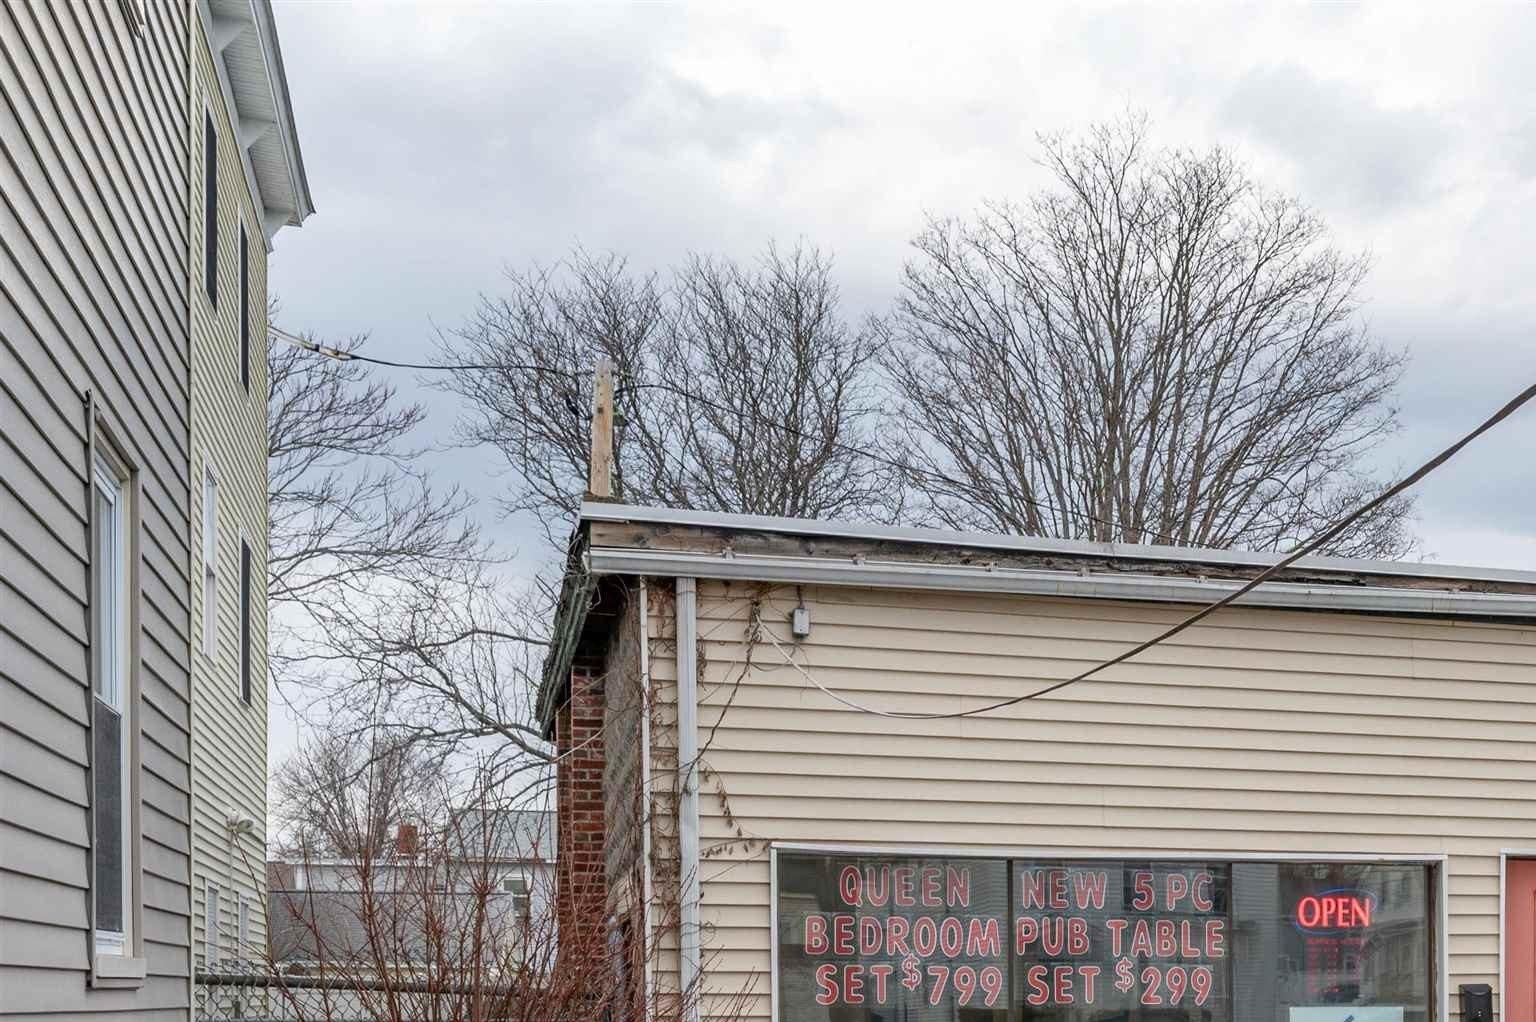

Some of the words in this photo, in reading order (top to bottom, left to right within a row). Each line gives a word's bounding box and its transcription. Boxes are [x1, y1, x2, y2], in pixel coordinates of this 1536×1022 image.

[839, 865, 970, 907] QUEEN
[1022, 870, 1107, 910] NEW
[1132, 872, 1155, 911] 5
[1166, 872, 1214, 912] PC
[1298, 896, 1370, 927] OPEN
[805, 916, 1001, 958] BEDROOM
[1016, 916, 1090, 956] PUB
[1106, 919, 1225, 958] TABLE
[815, 963, 893, 1005] SET
[901, 953, 1002, 1007] $799
[1027, 965, 1100, 1005] SET
[1114, 956, 1213, 1006] $299
